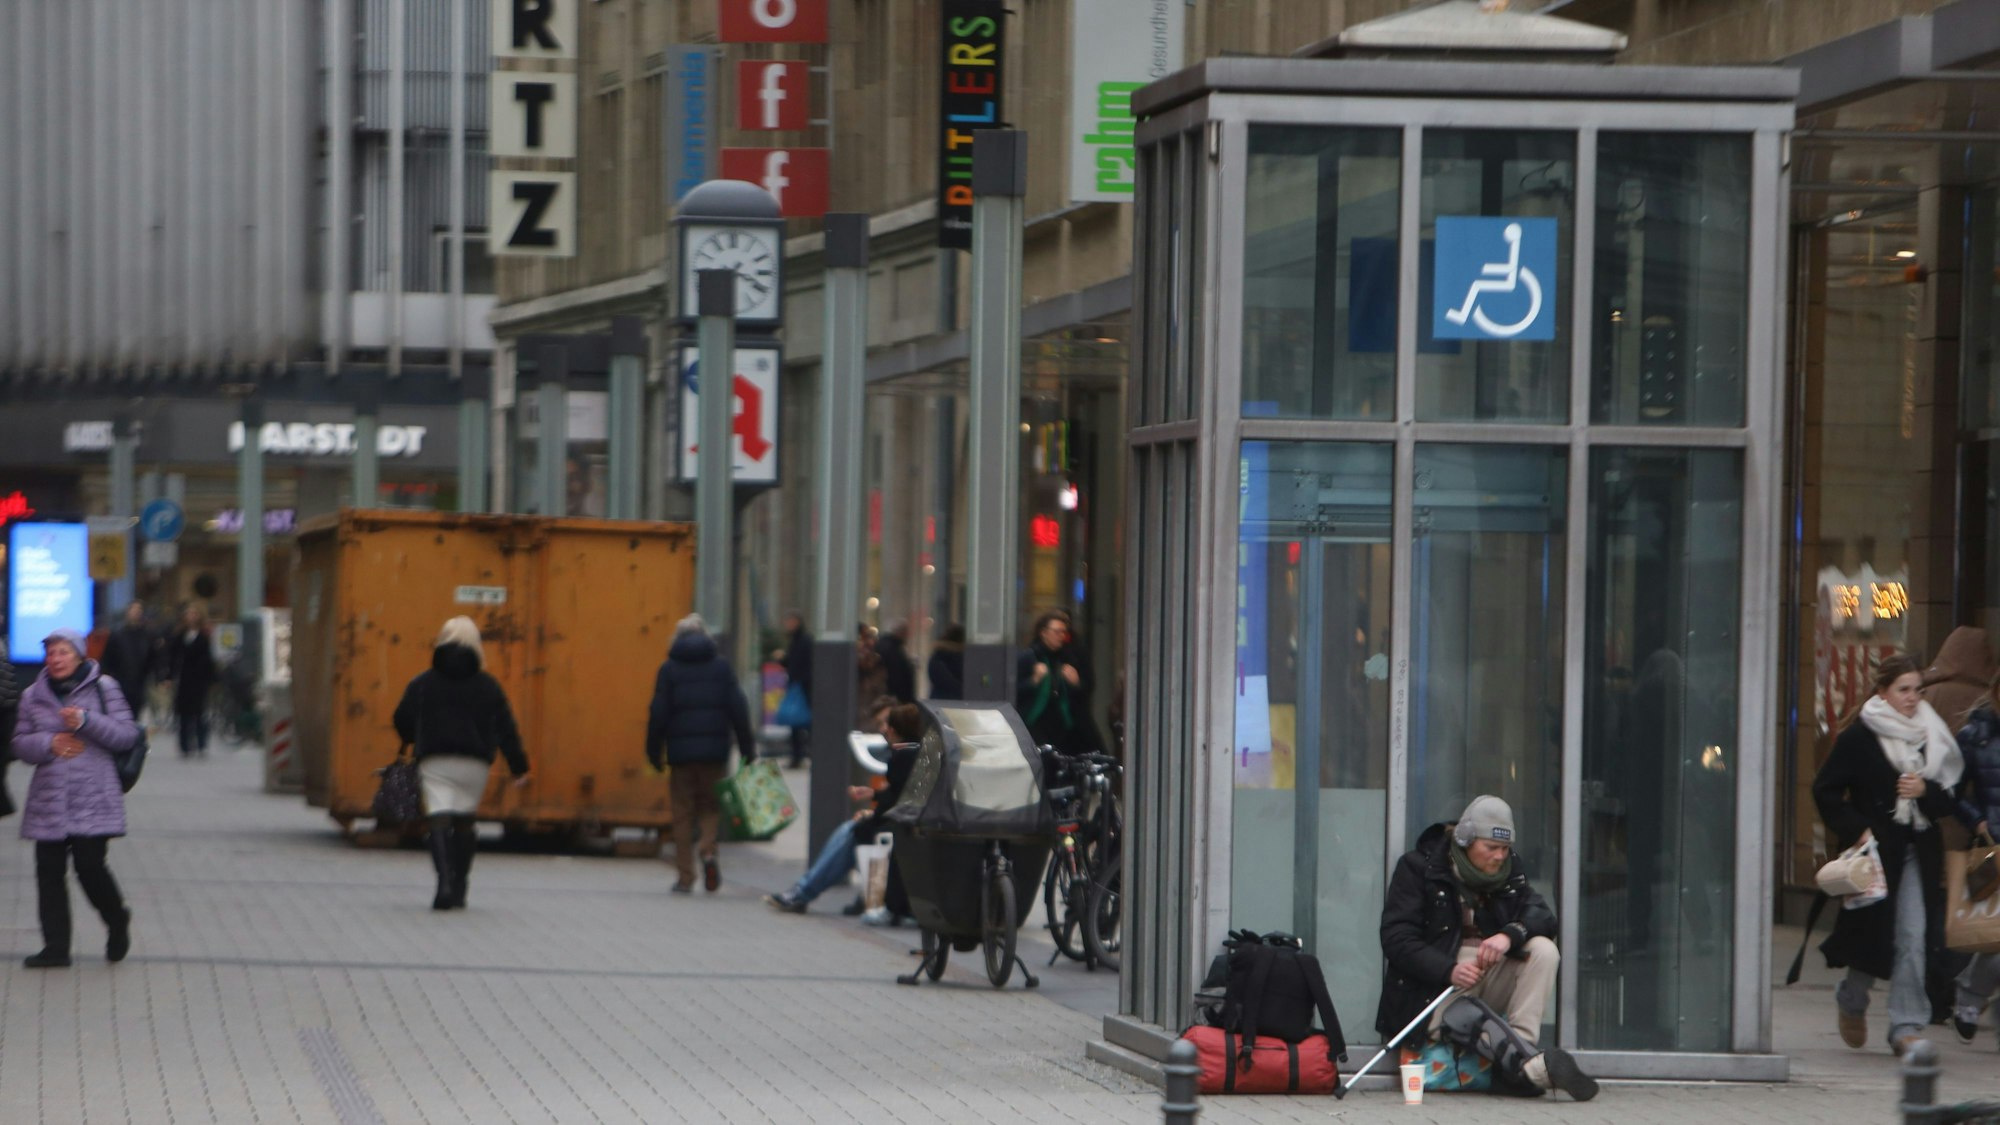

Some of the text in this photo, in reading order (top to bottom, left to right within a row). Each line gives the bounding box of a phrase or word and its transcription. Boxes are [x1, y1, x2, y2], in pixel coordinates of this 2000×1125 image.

[1150, 0, 1169, 78] Gesundhe
[1083, 81, 1149, 193] rahm
[228, 421, 426, 457] ARSTDT
